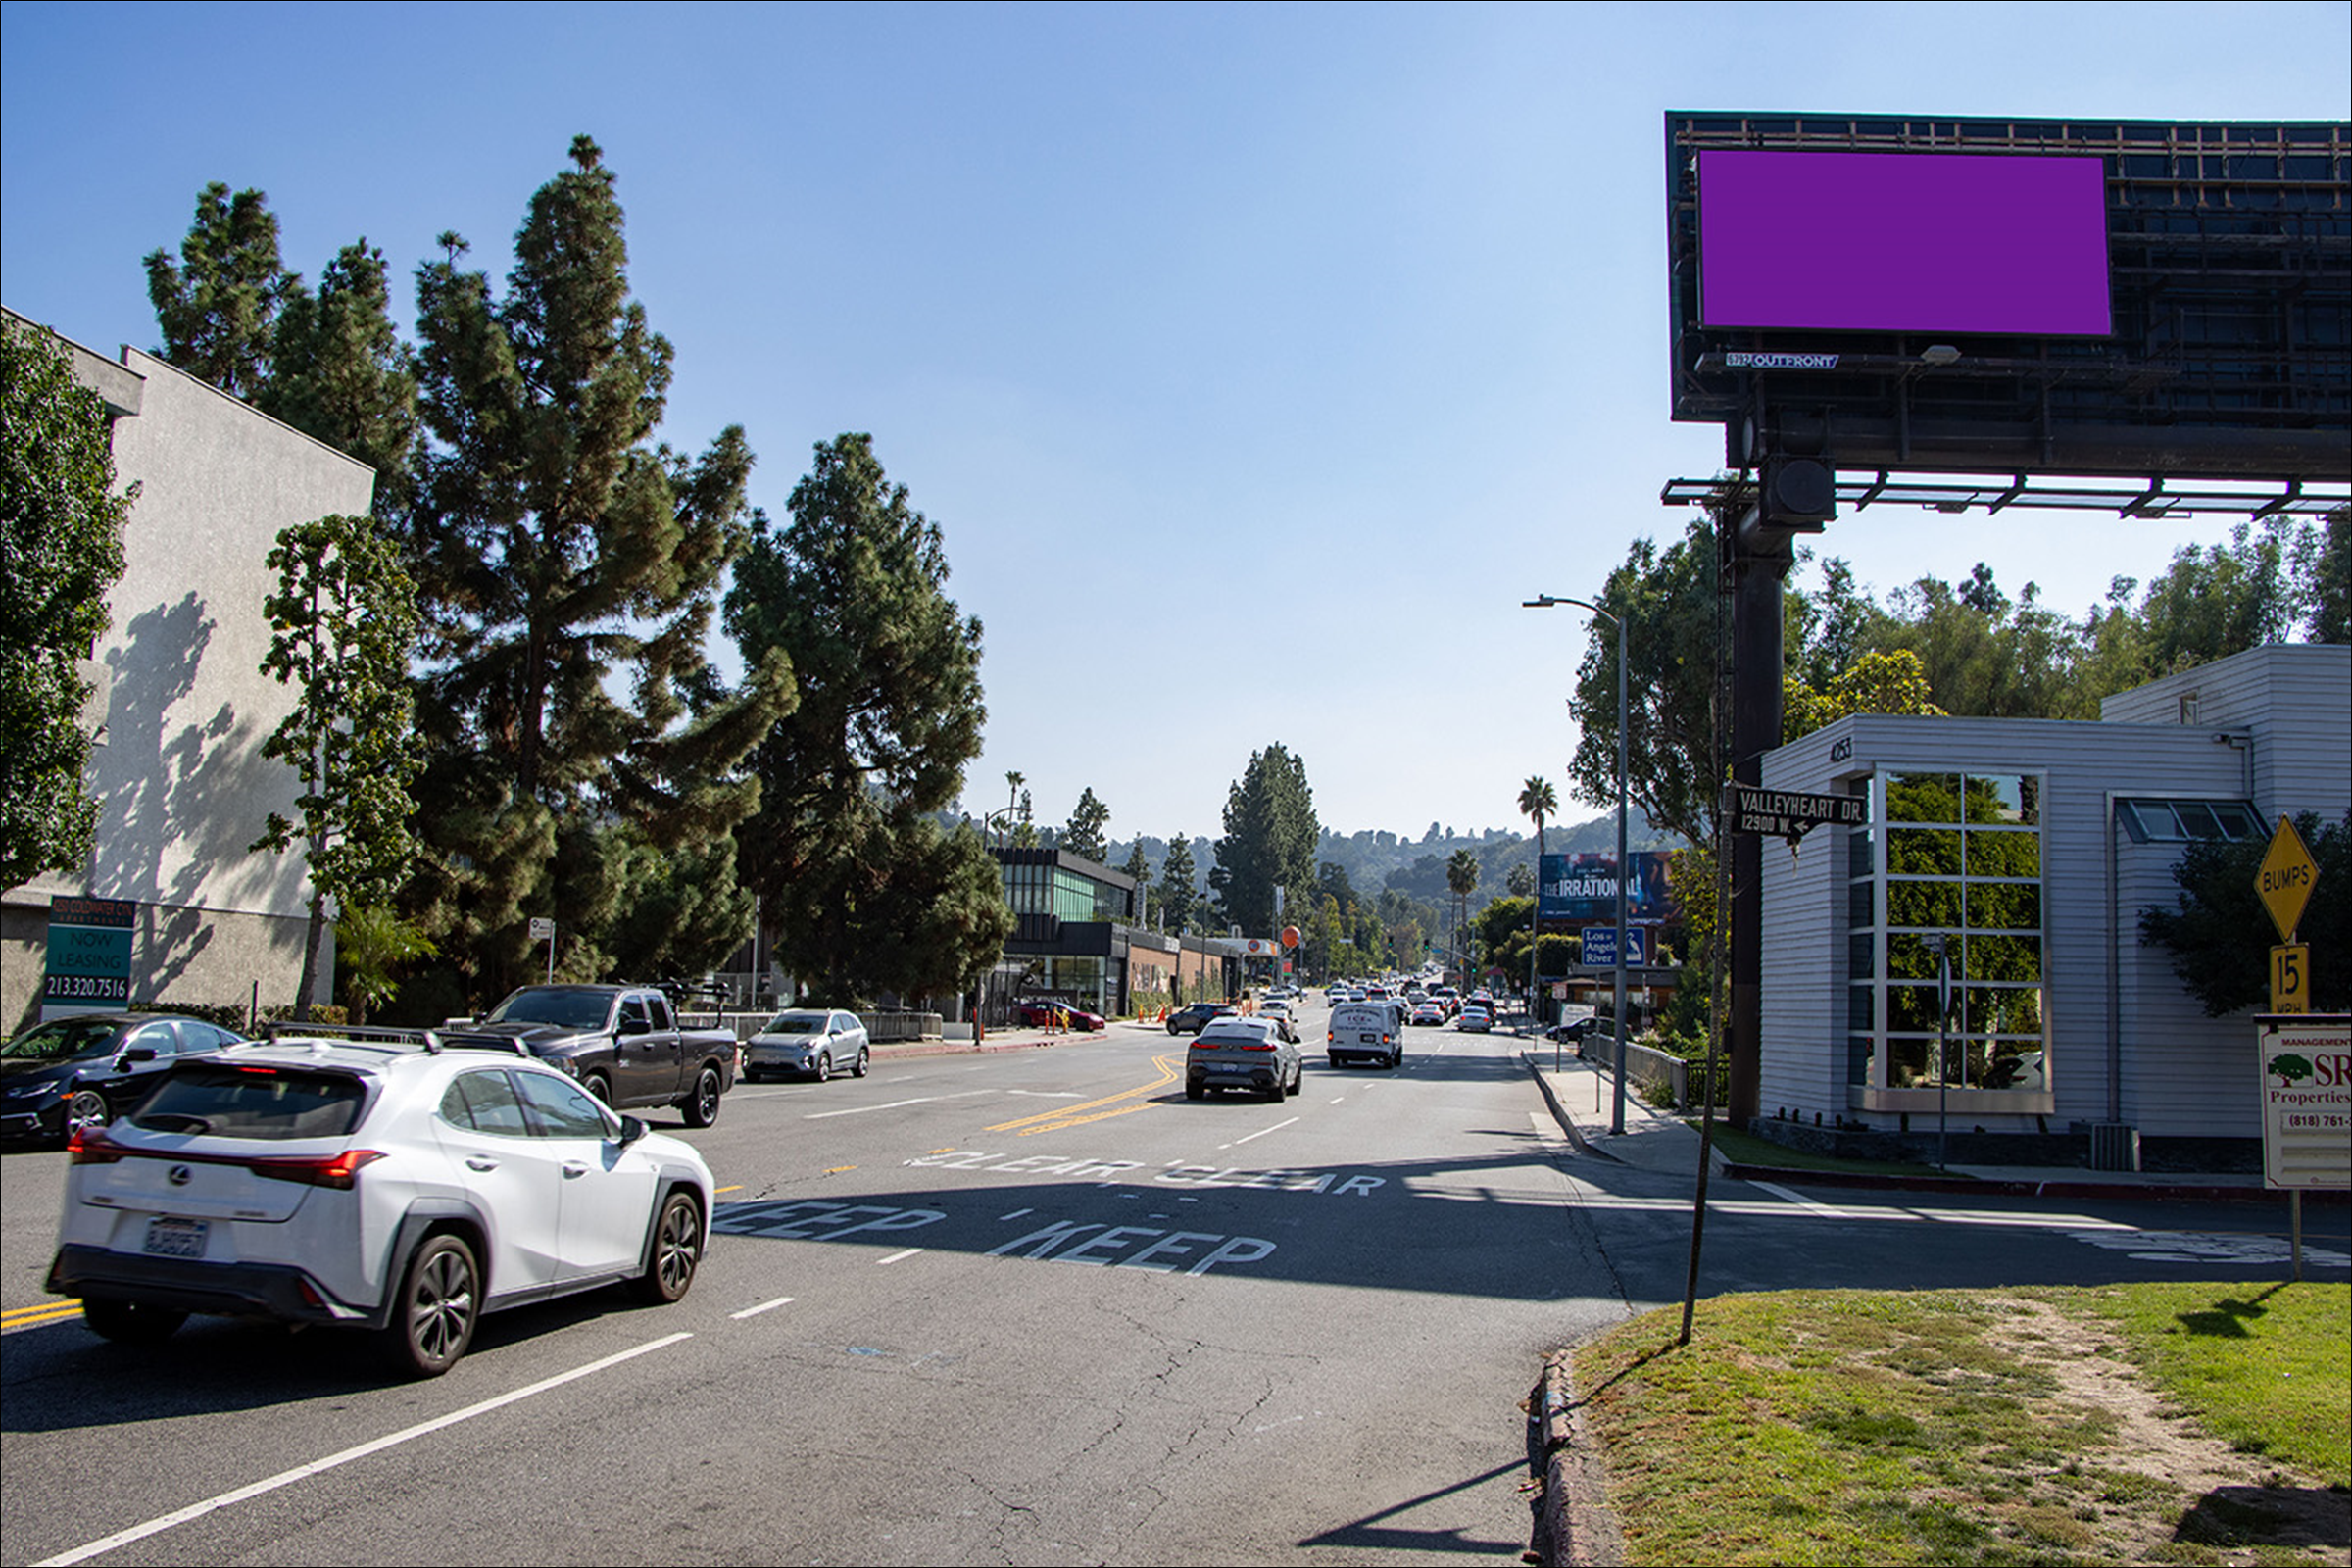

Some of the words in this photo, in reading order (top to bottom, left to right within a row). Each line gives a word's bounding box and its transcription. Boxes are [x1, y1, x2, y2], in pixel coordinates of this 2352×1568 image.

[1753, 355, 1834, 368] OUTFRONT
[1830, 737, 1853, 763] 4253
[1740, 791, 1836, 819] VALLEYHEART
[1741, 814, 1776, 832] 12900
[2263, 864, 2310, 892] BUMPS
[1544, 883, 1559, 897] THE
[70, 932, 114, 948] NOW
[1586, 931, 1604, 941] Los
[1585, 942, 1618, 954] Angele
[58, 953, 121, 969] LEASING
[1586, 953, 1613, 962] River
[2277, 954, 2300, 996] 15
[47, 976, 126, 998] 213.320.7516
[2270, 1090, 2351, 1106] Properties
[2289, 1114, 2320, 1128] (818)
[2323, 1114, 2351, 1127] 761-
[903, 1151, 1145, 1177] CLEAR
[1154, 1165, 1386, 1197] CLEAR
[984, 1220, 1277, 1277] KEEP
